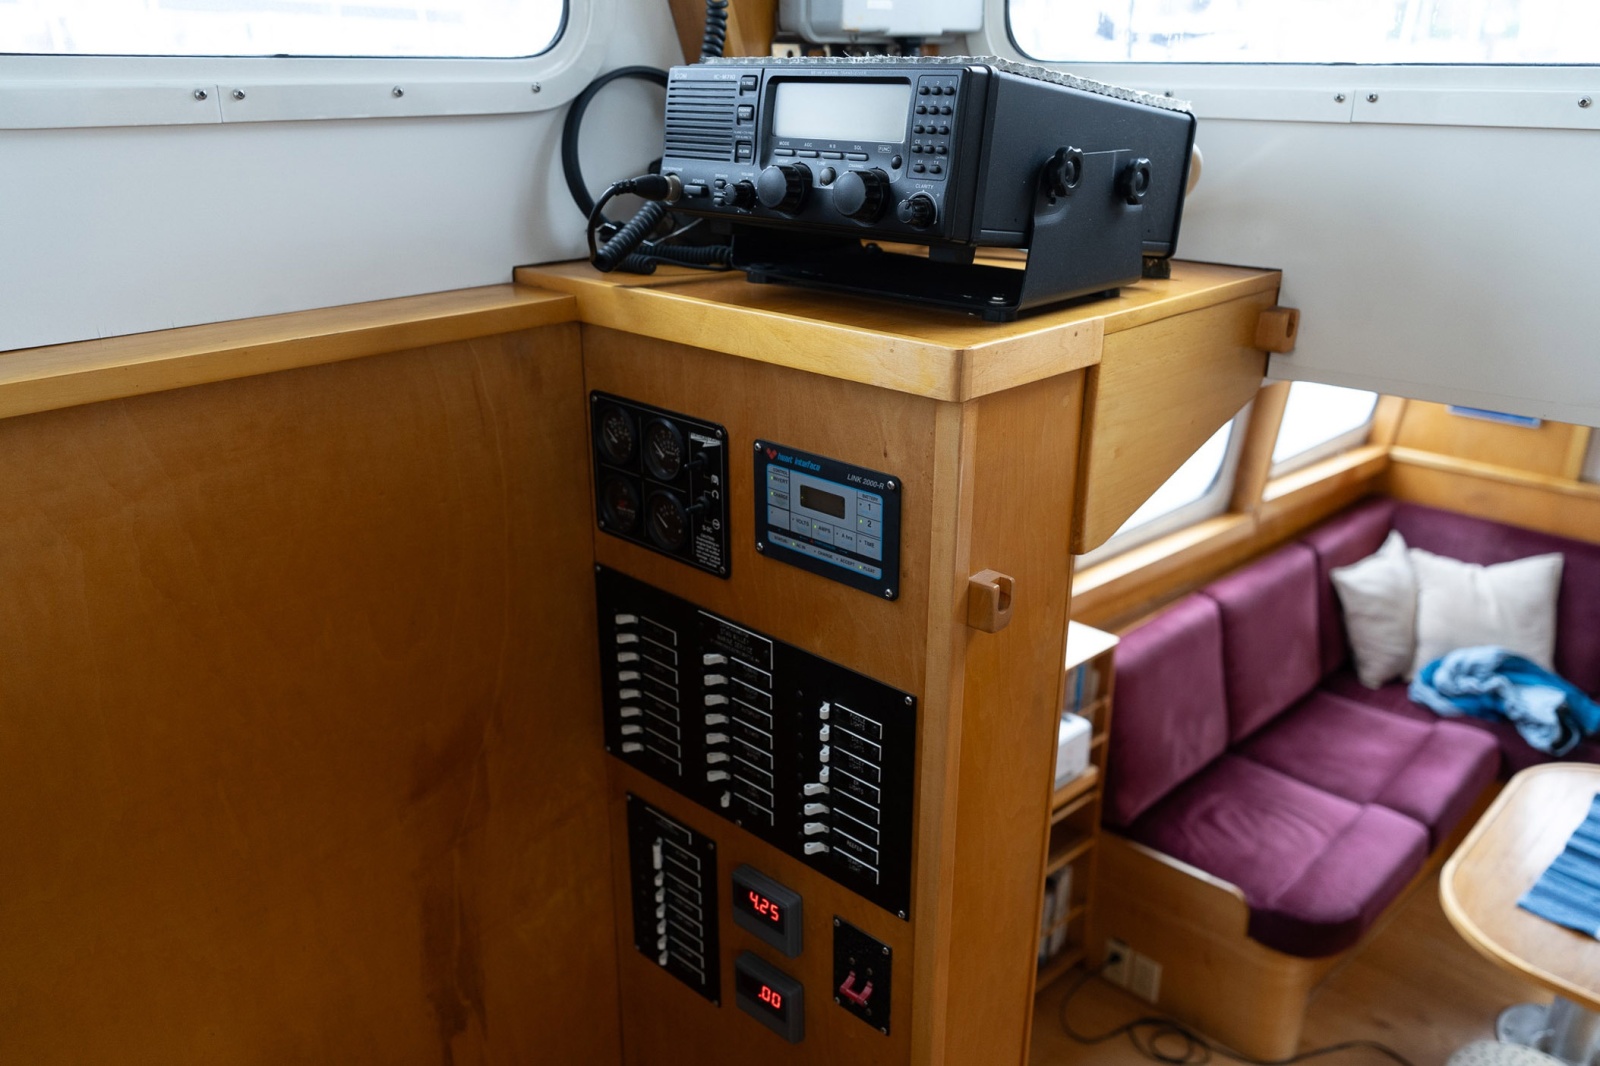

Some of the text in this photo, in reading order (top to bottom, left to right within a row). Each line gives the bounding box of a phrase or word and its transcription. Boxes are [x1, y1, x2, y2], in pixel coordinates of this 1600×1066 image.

[777, 452, 821, 472] heart interface
[847, 473, 885, 490] LINK 2000-R
[796, 517, 810, 527] VOLTS
[818, 526, 831, 534] AMPS
[864, 540, 875, 548] TIME
[749, 891, 780, 922] 4.25
